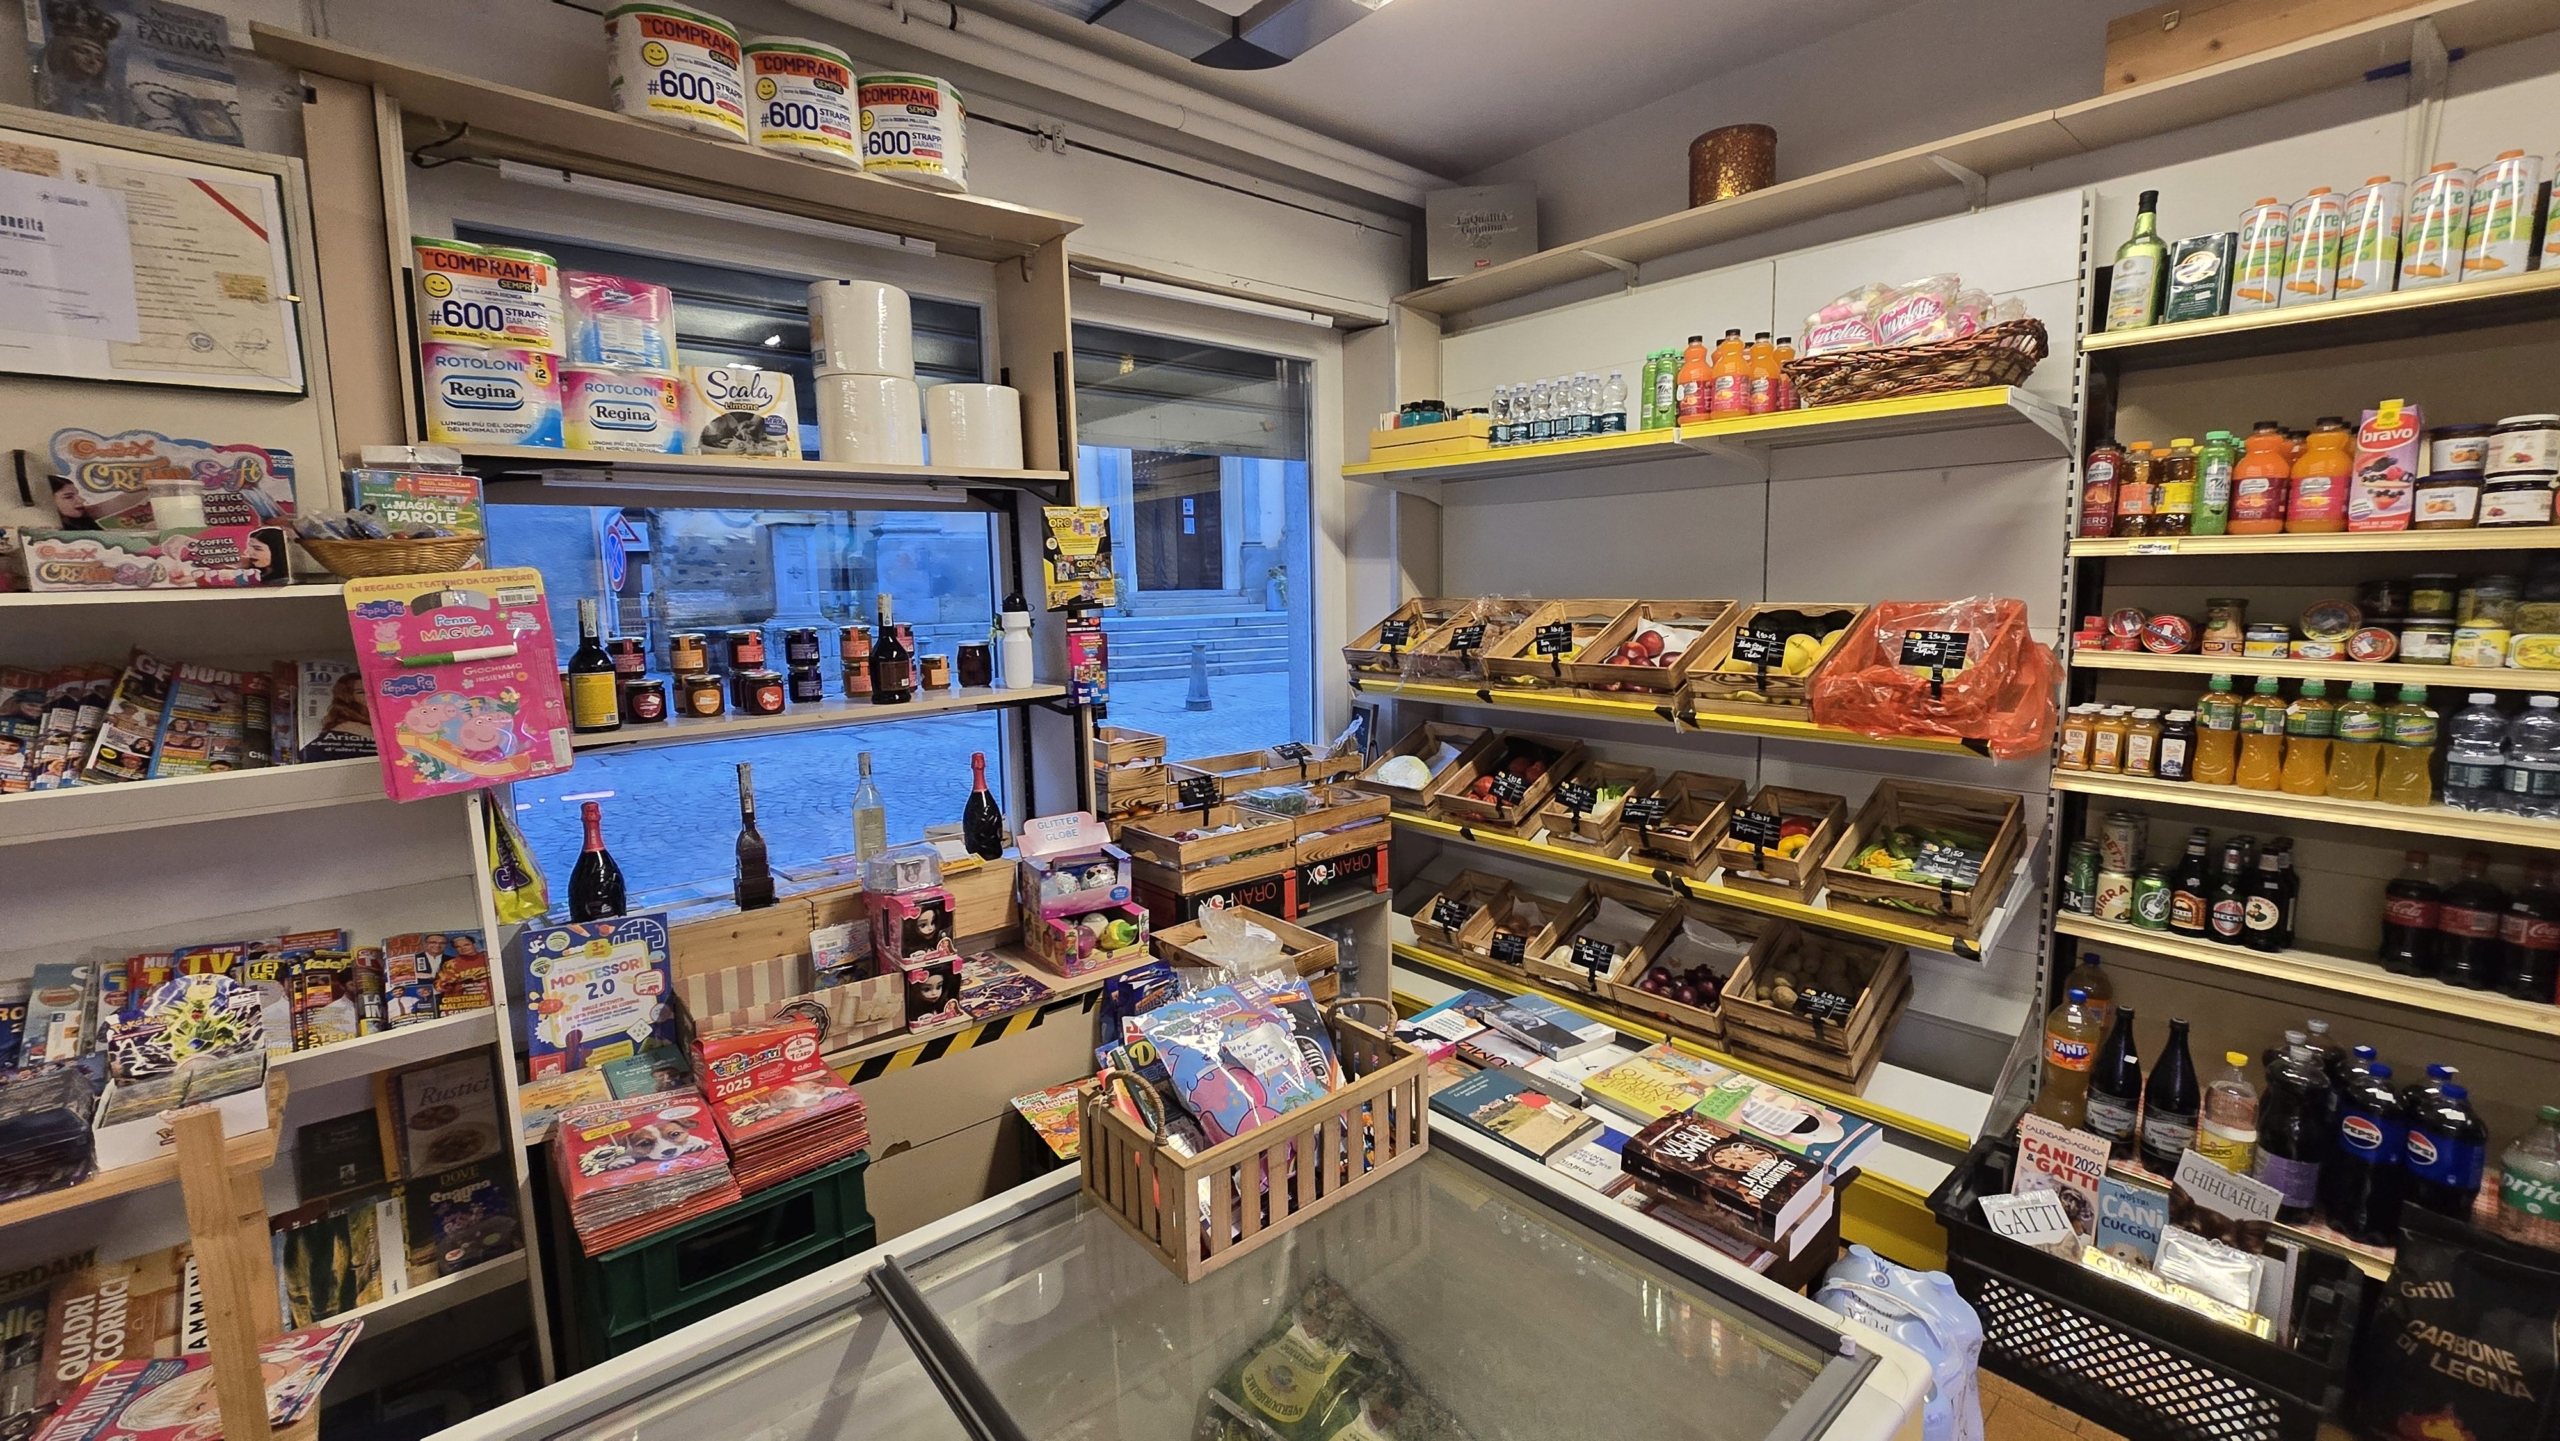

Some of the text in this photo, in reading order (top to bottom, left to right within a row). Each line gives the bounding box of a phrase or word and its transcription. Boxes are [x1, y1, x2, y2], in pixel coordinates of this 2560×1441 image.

[137, 25, 225, 58] FATIMA
[647, 69, 715, 105] #600
[815, 80, 844, 94] SEMPRE
[760, 101, 819, 131] #600
[907, 105, 936, 117] SEMPRE
[912, 132, 942, 142] STRAPP
[428, 300, 504, 331] #600
[435, 355, 524, 372] ROTOLONI
[450, 381, 517, 402] Regina
[585, 382, 658, 397] ROTOLONI
[706, 369, 773, 404] Scala
[596, 404, 651, 421] Regina
[724, 401, 760, 411] Limone
[440, 420, 470, 428] LUNGHI
[502, 422, 532, 430] DOPPIO
[462, 427, 499, 435] NORMALI
[2361, 427, 2413, 444] bravo
[204, 506, 250, 514] REMOSO
[393, 500, 437, 511] MAGIA
[387, 510, 457, 525] PAROLE
[1049, 518, 1072, 528] ORO
[200, 537, 234, 547] SOFFICE
[199, 547, 240, 556] CREMOSO
[201, 556, 241, 566] SQUISHY
[352, 585, 362, 593] IN
[364, 583, 404, 593] REGALO
[418, 578, 464, 589] TEATRINO
[466, 577, 479, 585] DA
[356, 601, 404, 617] Peppa Pig
[434, 614, 476, 627] Penna
[420, 625, 493, 642] MAGICA
[463, 662, 523, 676] GIOCHIAMO
[475, 671, 514, 683] INSIEME!
[382, 675, 436, 696] Peppa Pig
[1036, 814, 1080, 831] GLITTER
[1045, 828, 1079, 842] GLOBE
[2095, 884, 2129, 917] BIRRA
[183, 952, 235, 976] TV
[550, 956, 644, 990] MONTESSORI
[585, 978, 616, 1001] 2.0
[439, 1000, 490, 1011] MALGIOGLIO
[441, 994, 486, 1004] CRISTIANO
[796, 1050, 812, 1059] CARD
[2053, 1039, 2090, 1057] FANTA
[418, 1073, 491, 1108] Rustici
[716, 1076, 752, 1098] 2025
[1610, 1080, 1659, 1104] STORIE
[1611, 1073, 1675, 1100] ANTICO
[587, 1101, 622, 1112] ALBUM
[1655, 1124, 1710, 1157] WILBUR
[2025, 1123, 2106, 1158] CALENDARIO-AGENDA
[2343, 1122, 2380, 1142] PEPSI
[1674, 1132, 1722, 1162] SMITH
[2023, 1137, 2103, 1176] CANI 2025
[440, 1165, 480, 1187] DOVE
[1758, 1159, 1798, 1190] COURTNEY
[2026, 1153, 2099, 1190] & GATTI
[430, 1179, 491, 1204] Spagna
[1748, 1183, 1770, 1200] DEI
[2181, 1164, 2272, 1219] CHIHUAHUA
[1992, 1203, 2069, 1236] GATTI
[2400, 1281, 2456, 1299] Grill
[93, 1275, 130, 1361] CORNICI
[56, 1293, 96, 1381] QUADRI
[2407, 1319, 2523, 1377] CARBONE
[2396, 1333, 2536, 1402] DI LEGNA
